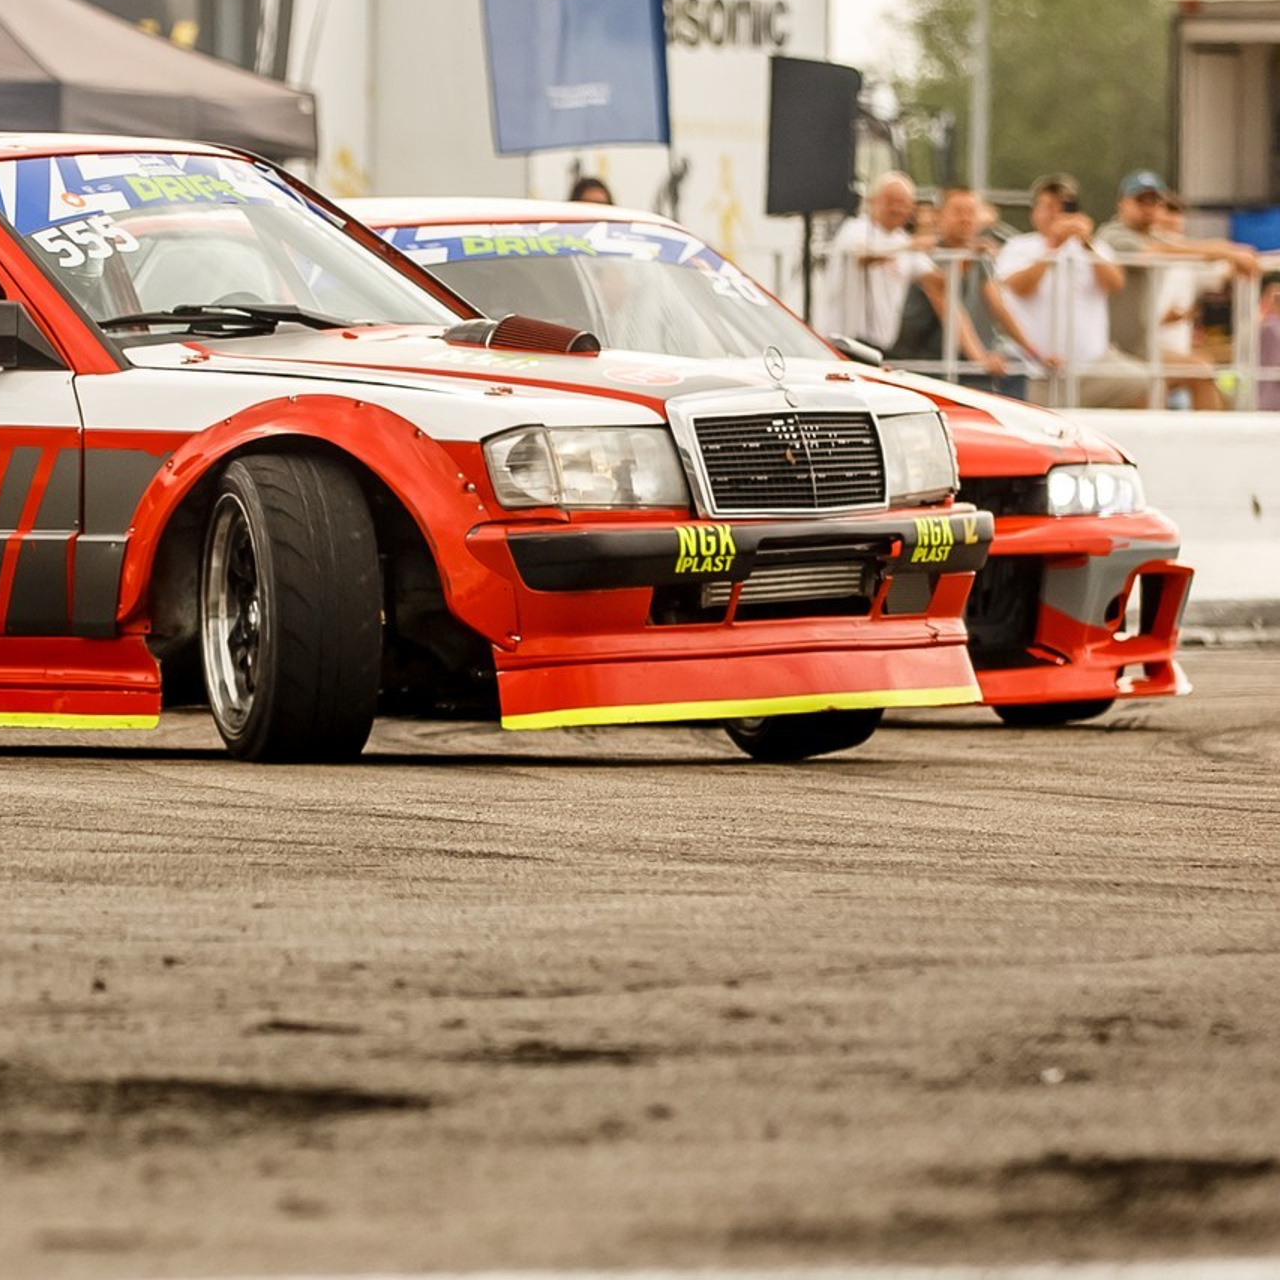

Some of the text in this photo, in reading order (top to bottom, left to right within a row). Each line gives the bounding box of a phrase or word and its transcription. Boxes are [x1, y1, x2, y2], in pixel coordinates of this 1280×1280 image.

[31, 215, 140, 268] 555
[674, 524, 737, 557] NGK
[913, 516, 955, 547] NGK
